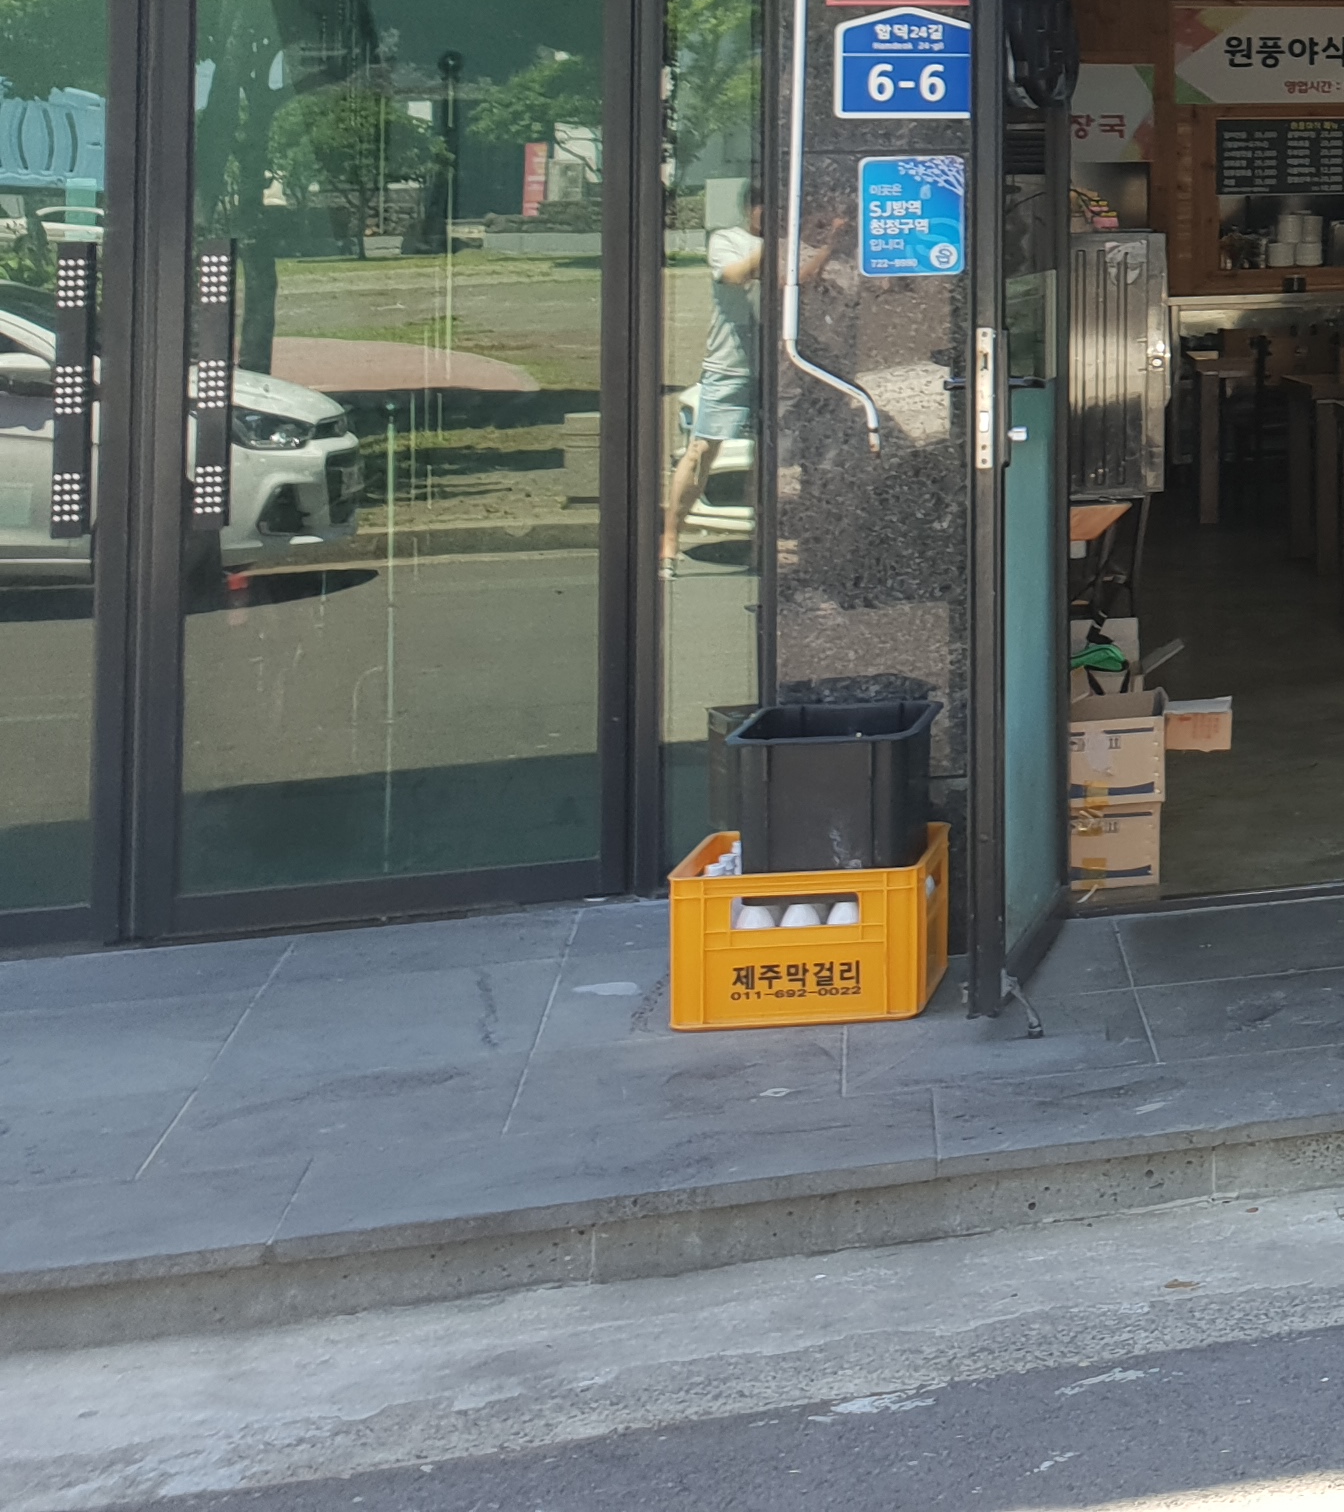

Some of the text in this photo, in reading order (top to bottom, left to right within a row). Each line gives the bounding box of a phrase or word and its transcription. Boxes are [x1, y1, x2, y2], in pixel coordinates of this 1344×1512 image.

[874, 23, 943, 40] 함덕24길
[867, 62, 946, 103] 6-6
[1284, 80, 1332, 94] 영업시간
[869, 199, 922, 218] SJ방역
[870, 218, 929, 235] 청정구역
[869, 238, 905, 252] 입니다
[732, 959, 861, 990] 제주막걸리
[730, 985, 862, 1001] 011-692-0022
